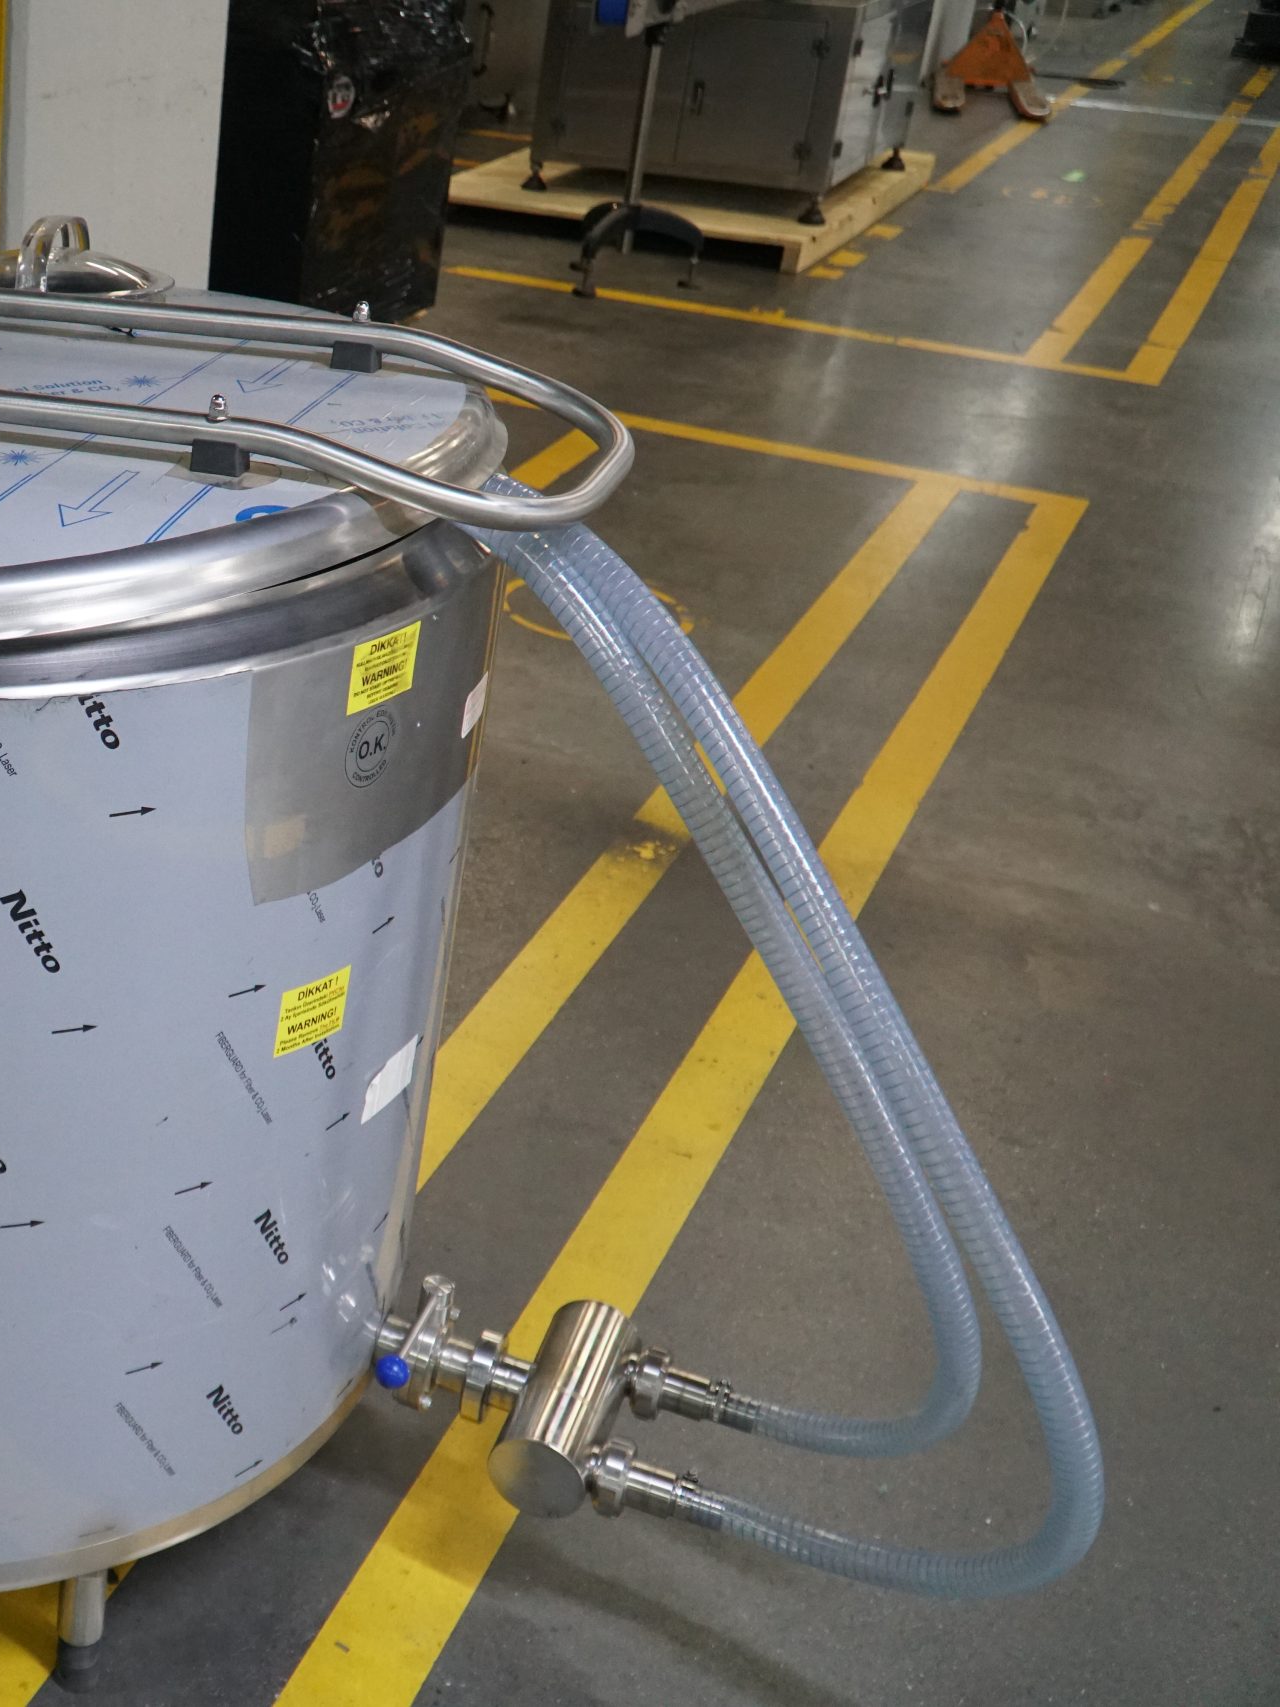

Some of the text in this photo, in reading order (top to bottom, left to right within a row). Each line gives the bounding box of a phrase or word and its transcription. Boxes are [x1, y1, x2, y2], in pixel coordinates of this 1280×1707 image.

[358, 733, 387, 760] O.K.
[0, 889, 61, 974] Nitto
[287, 1007, 338, 1036] WARNING!
[312, 1038, 336, 1080] itto
[253, 1208, 289, 1265] Nitto
[206, 1384, 244, 1435] Nitto
